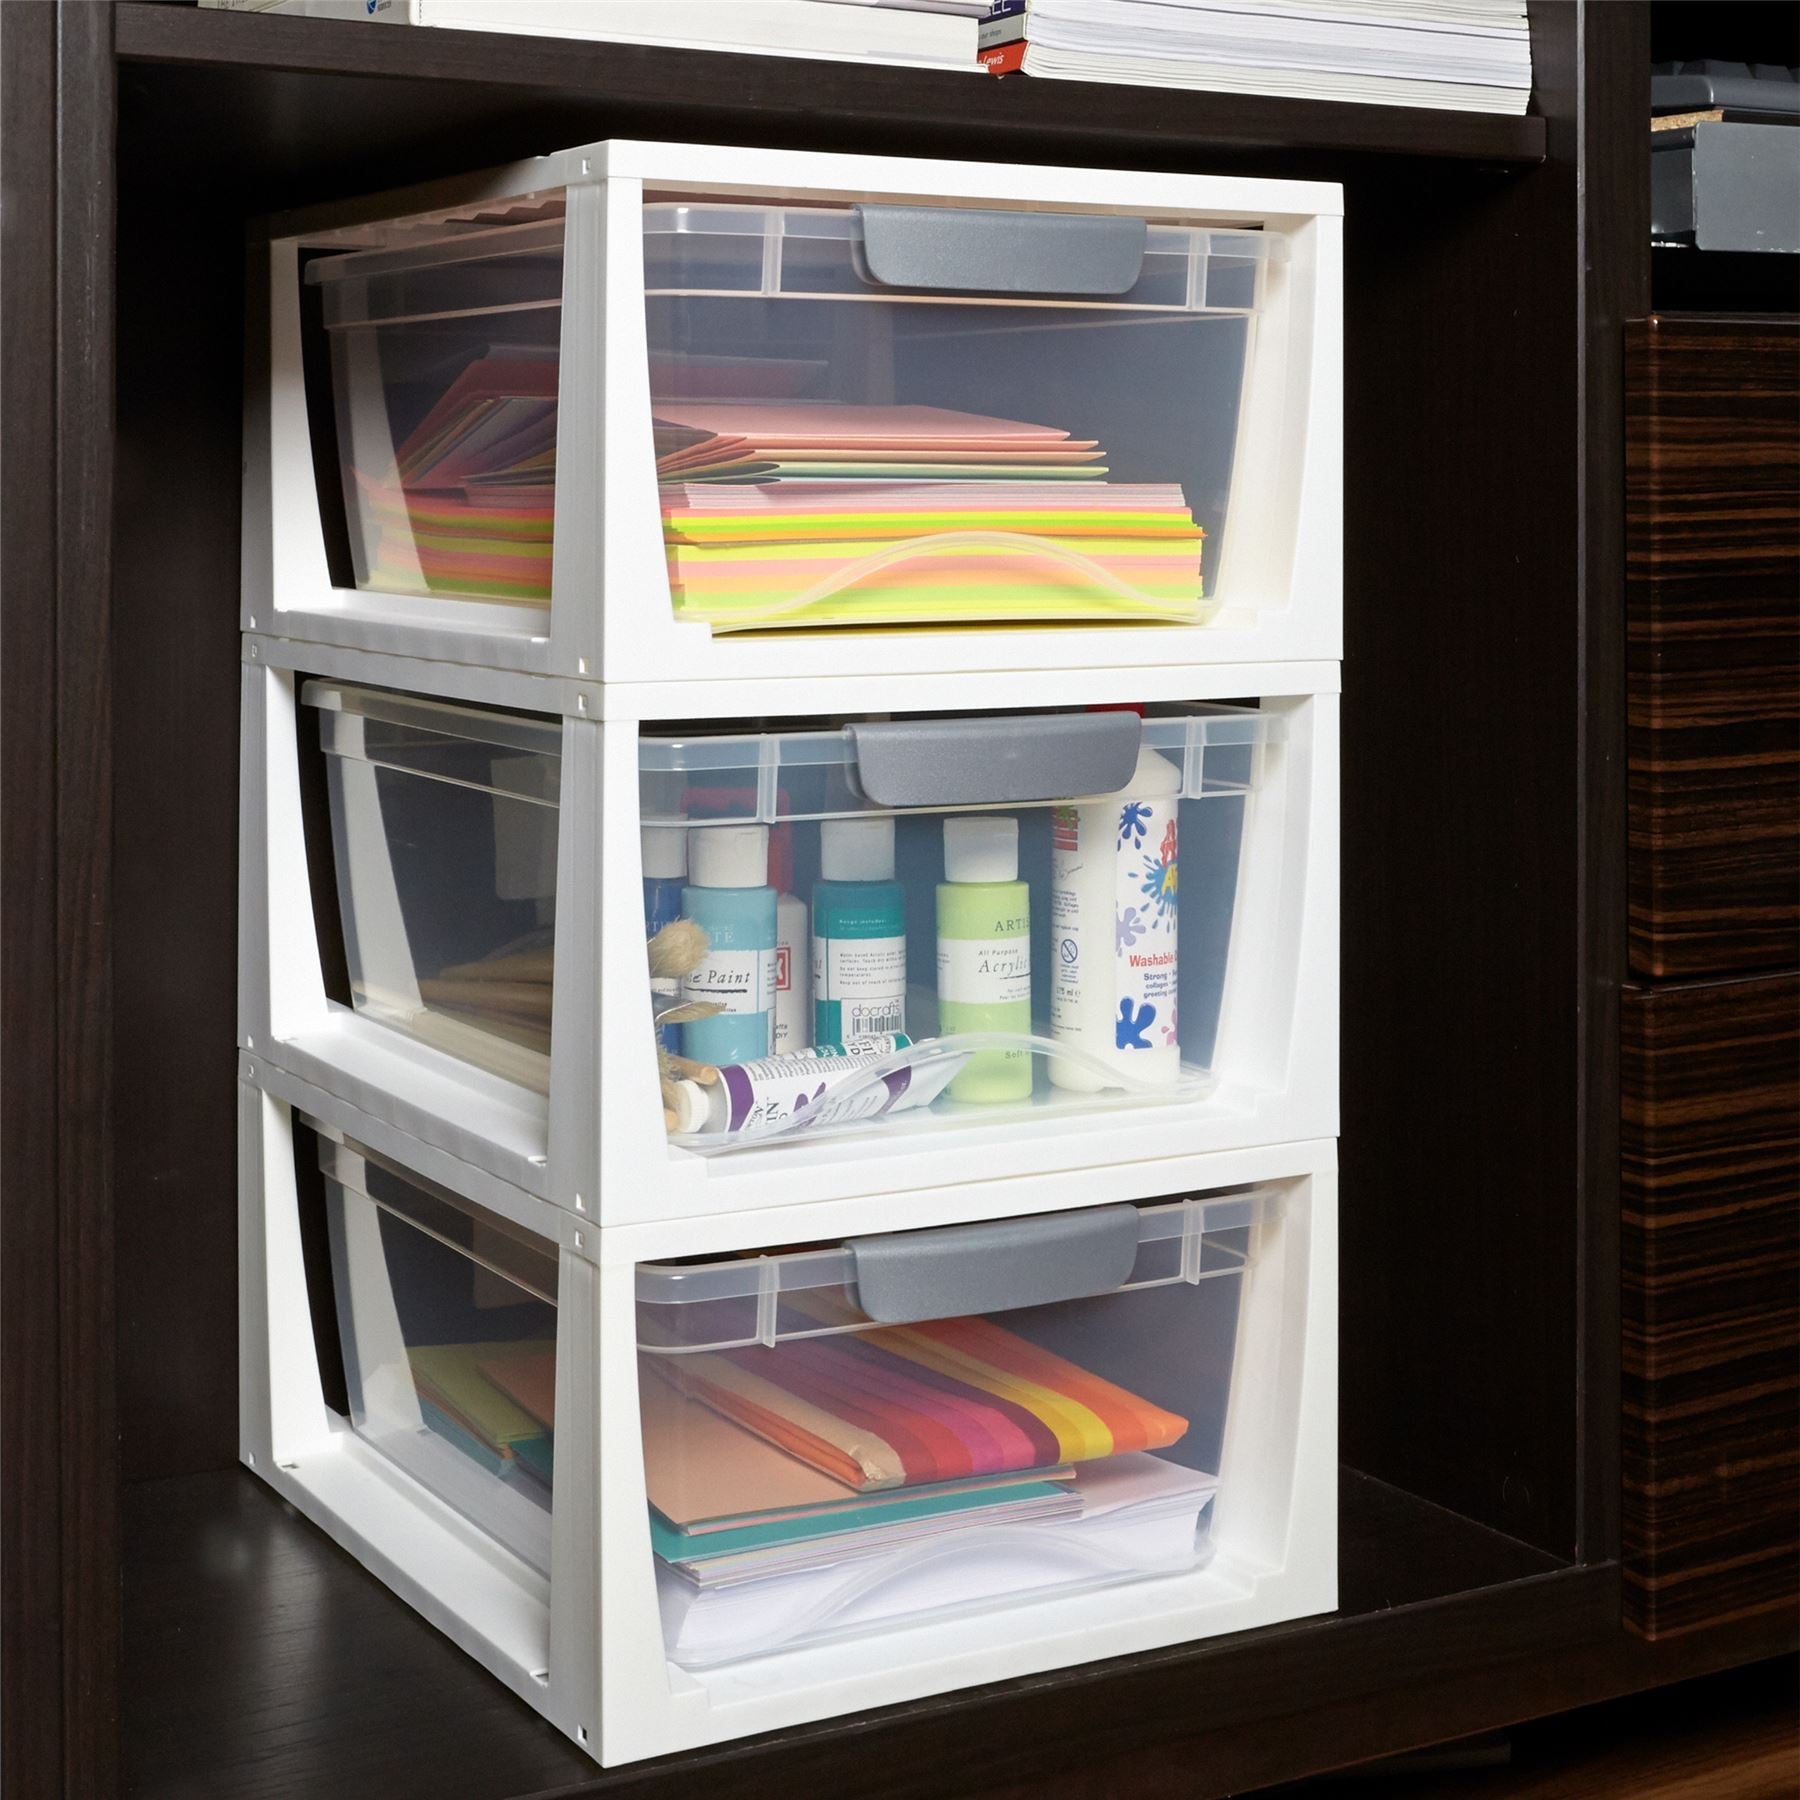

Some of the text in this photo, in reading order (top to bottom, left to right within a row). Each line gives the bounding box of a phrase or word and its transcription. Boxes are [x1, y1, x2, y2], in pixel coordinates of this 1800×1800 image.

[1129, 951, 1173, 967] Washable
[708, 970, 750, 984] Paint
[1144, 972, 1167, 980] Strong
[852, 1000, 900, 1017] docrafts
